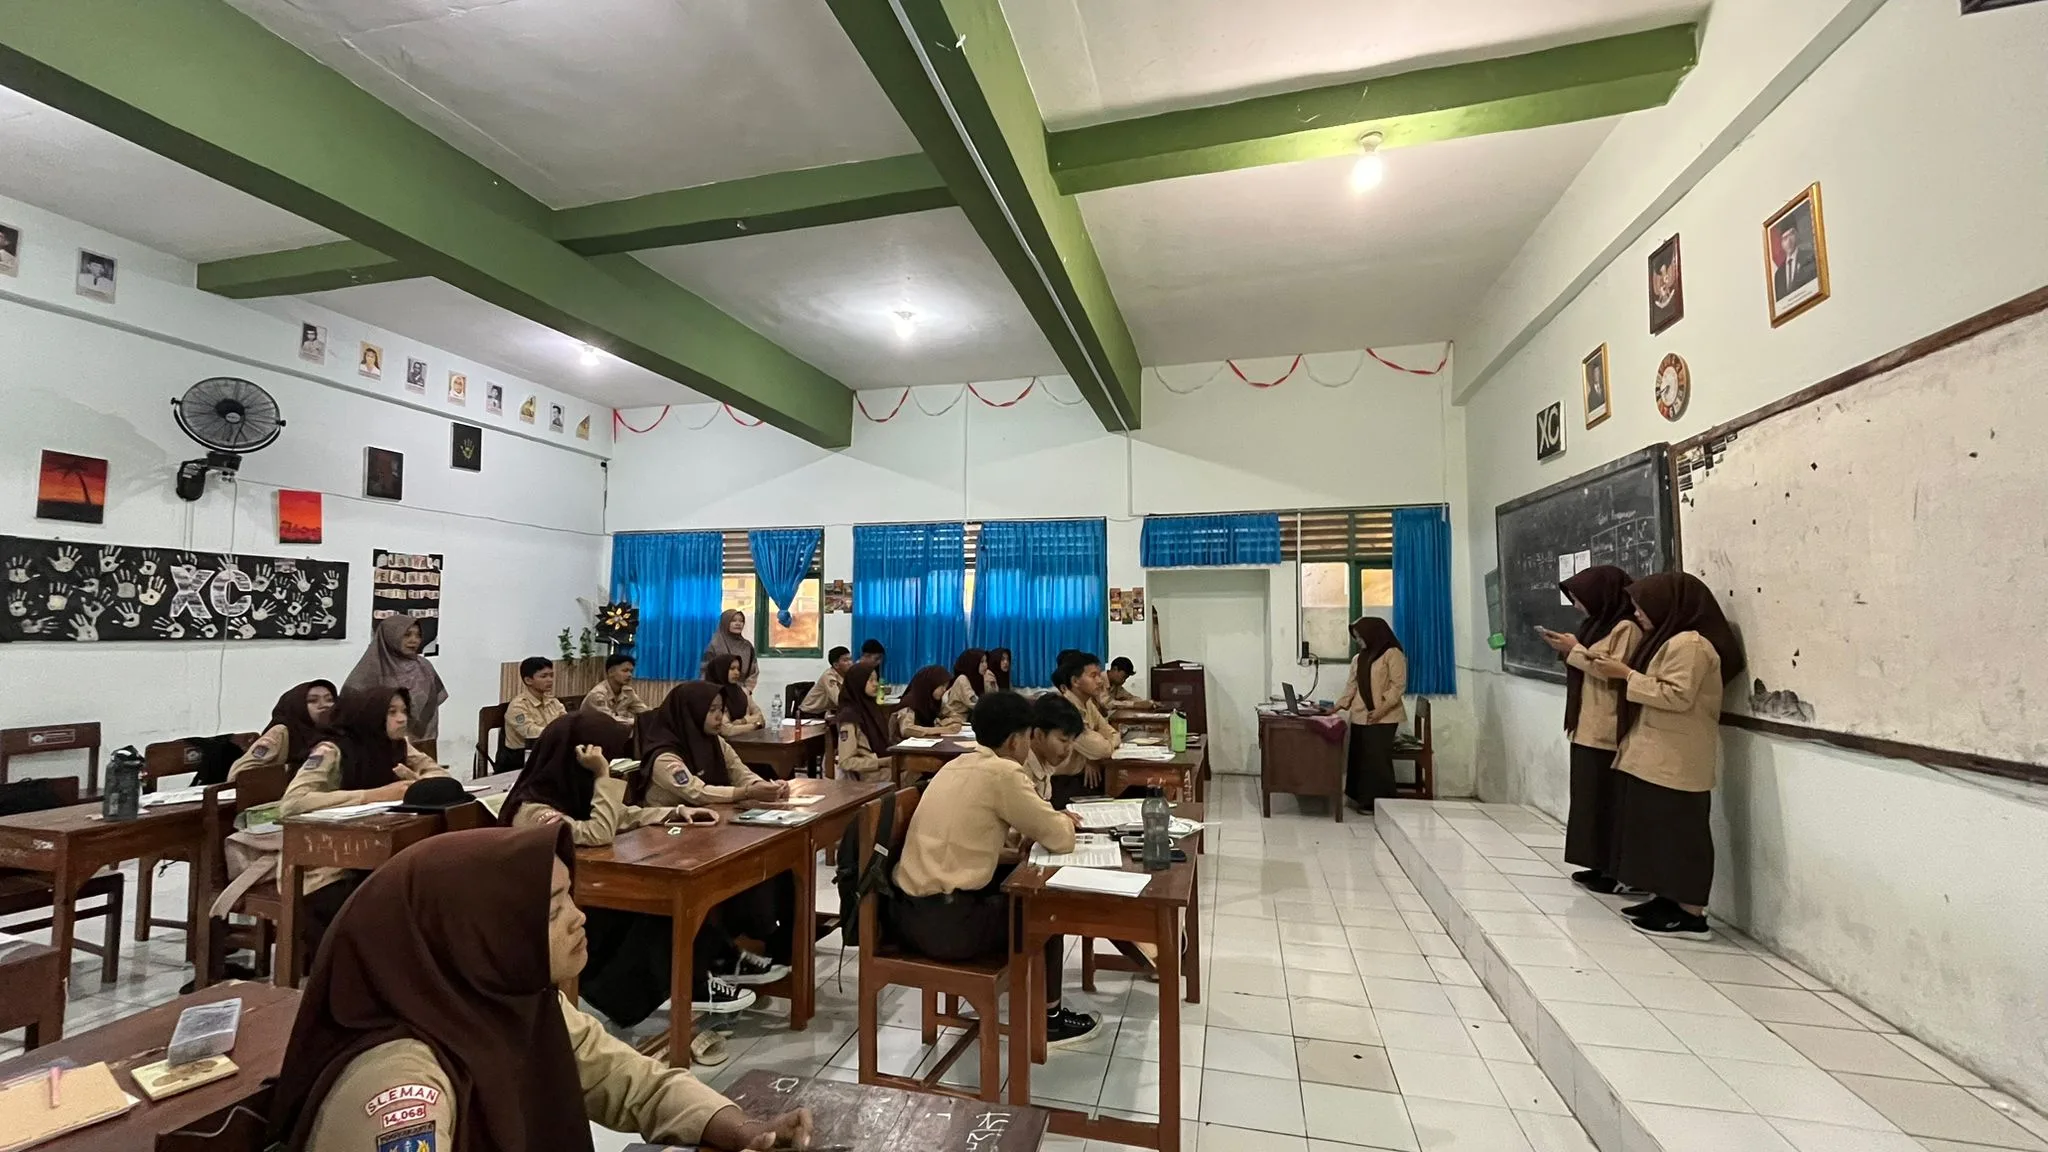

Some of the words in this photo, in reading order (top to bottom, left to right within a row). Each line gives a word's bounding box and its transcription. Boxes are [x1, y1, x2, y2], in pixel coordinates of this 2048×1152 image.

[1538, 405, 1560, 454] XC
[170, 565, 252, 619] XC
[367, 1086, 437, 1113] SLEMAN
[385, 1107, 425, 1125] 14.068
